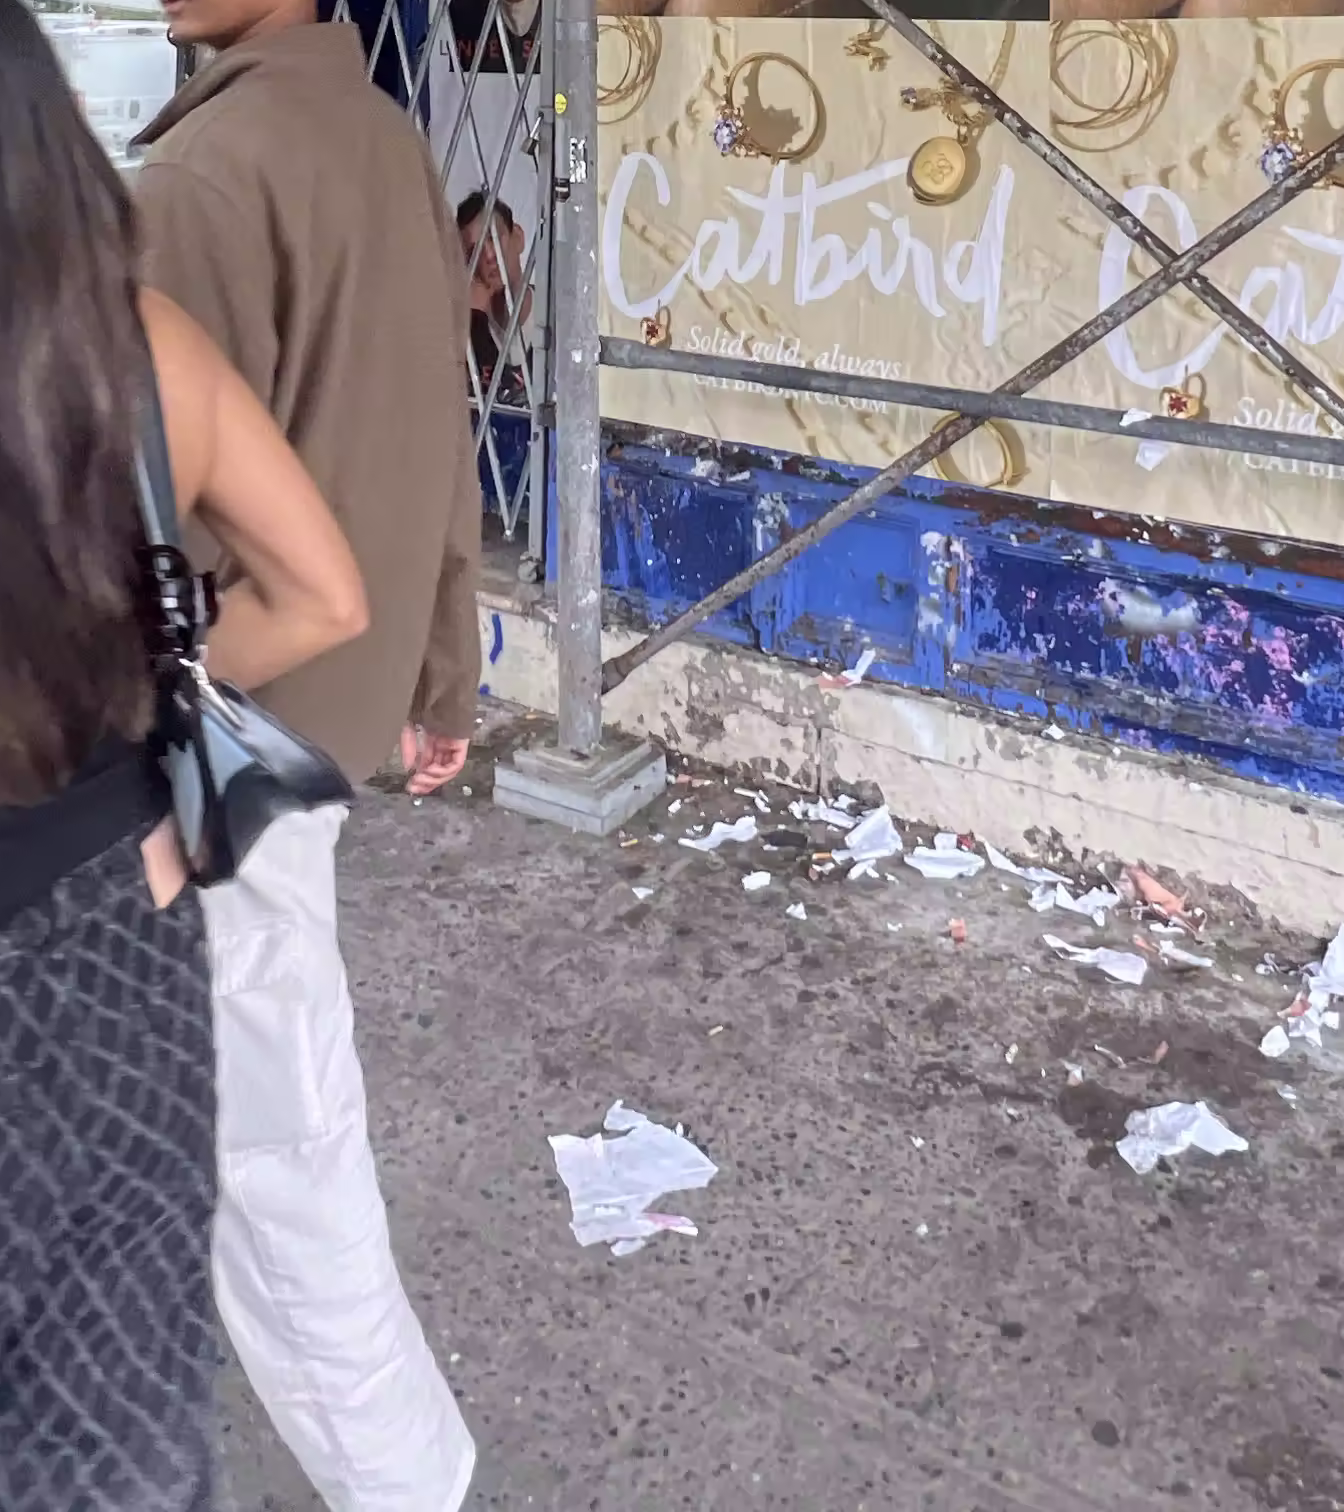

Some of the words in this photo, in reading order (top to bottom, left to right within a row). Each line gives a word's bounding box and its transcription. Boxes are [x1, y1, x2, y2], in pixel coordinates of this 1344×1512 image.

[602, 150, 1014, 347] Catbird
[688, 325, 746, 357] Solid
[749, 335, 805, 369] gold,
[814, 343, 903, 379] always
[1233, 396, 1321, 436] Solid
